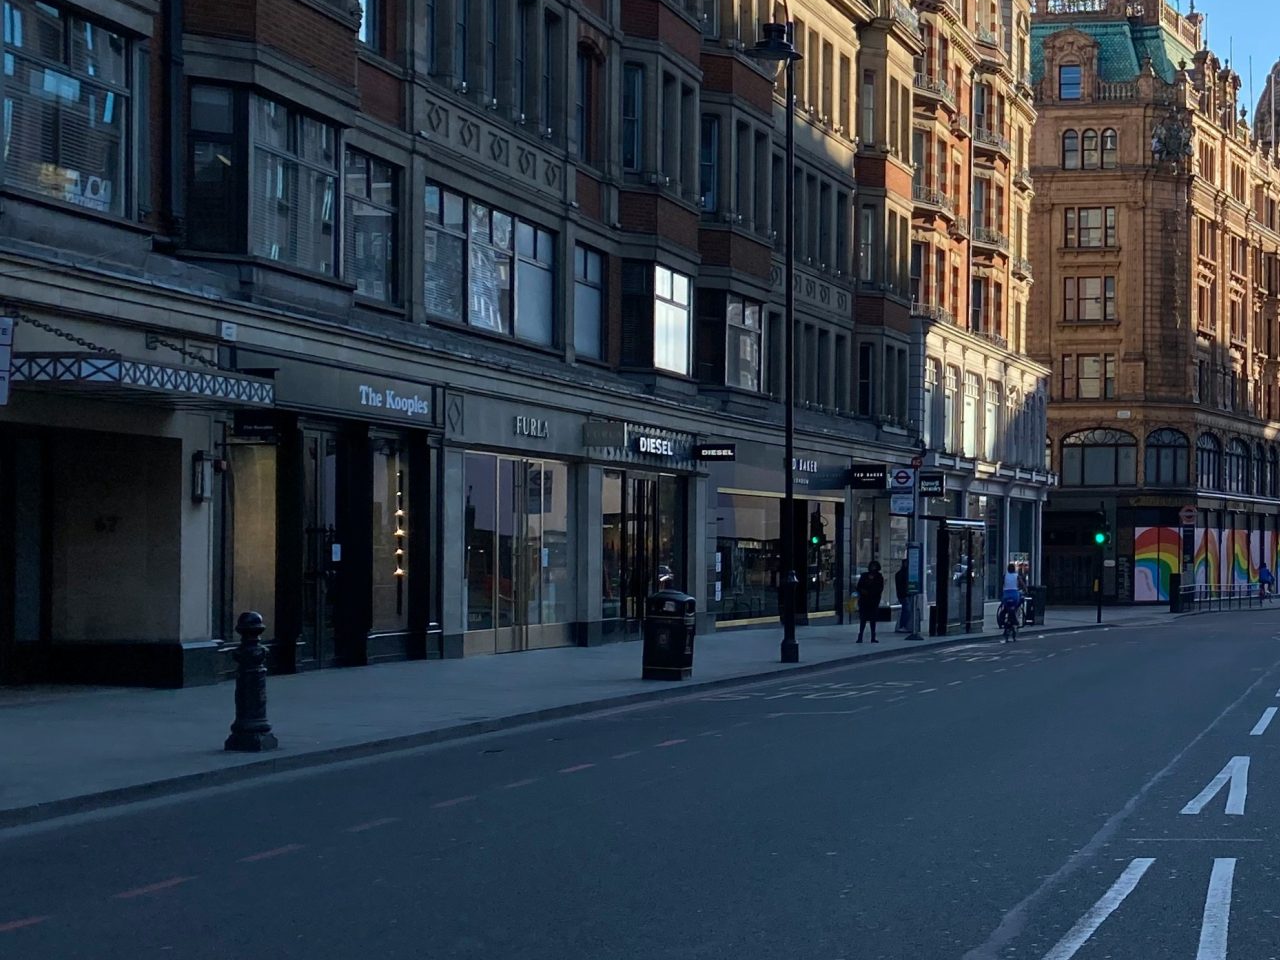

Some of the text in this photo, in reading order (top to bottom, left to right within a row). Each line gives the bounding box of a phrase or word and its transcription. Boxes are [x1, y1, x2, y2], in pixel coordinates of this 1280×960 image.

[359, 385, 429, 416] The Kooples
[516, 415, 550, 438] FURLA
[639, 437, 674, 456] DIESEL
[799, 458, 817, 473] BAKER
